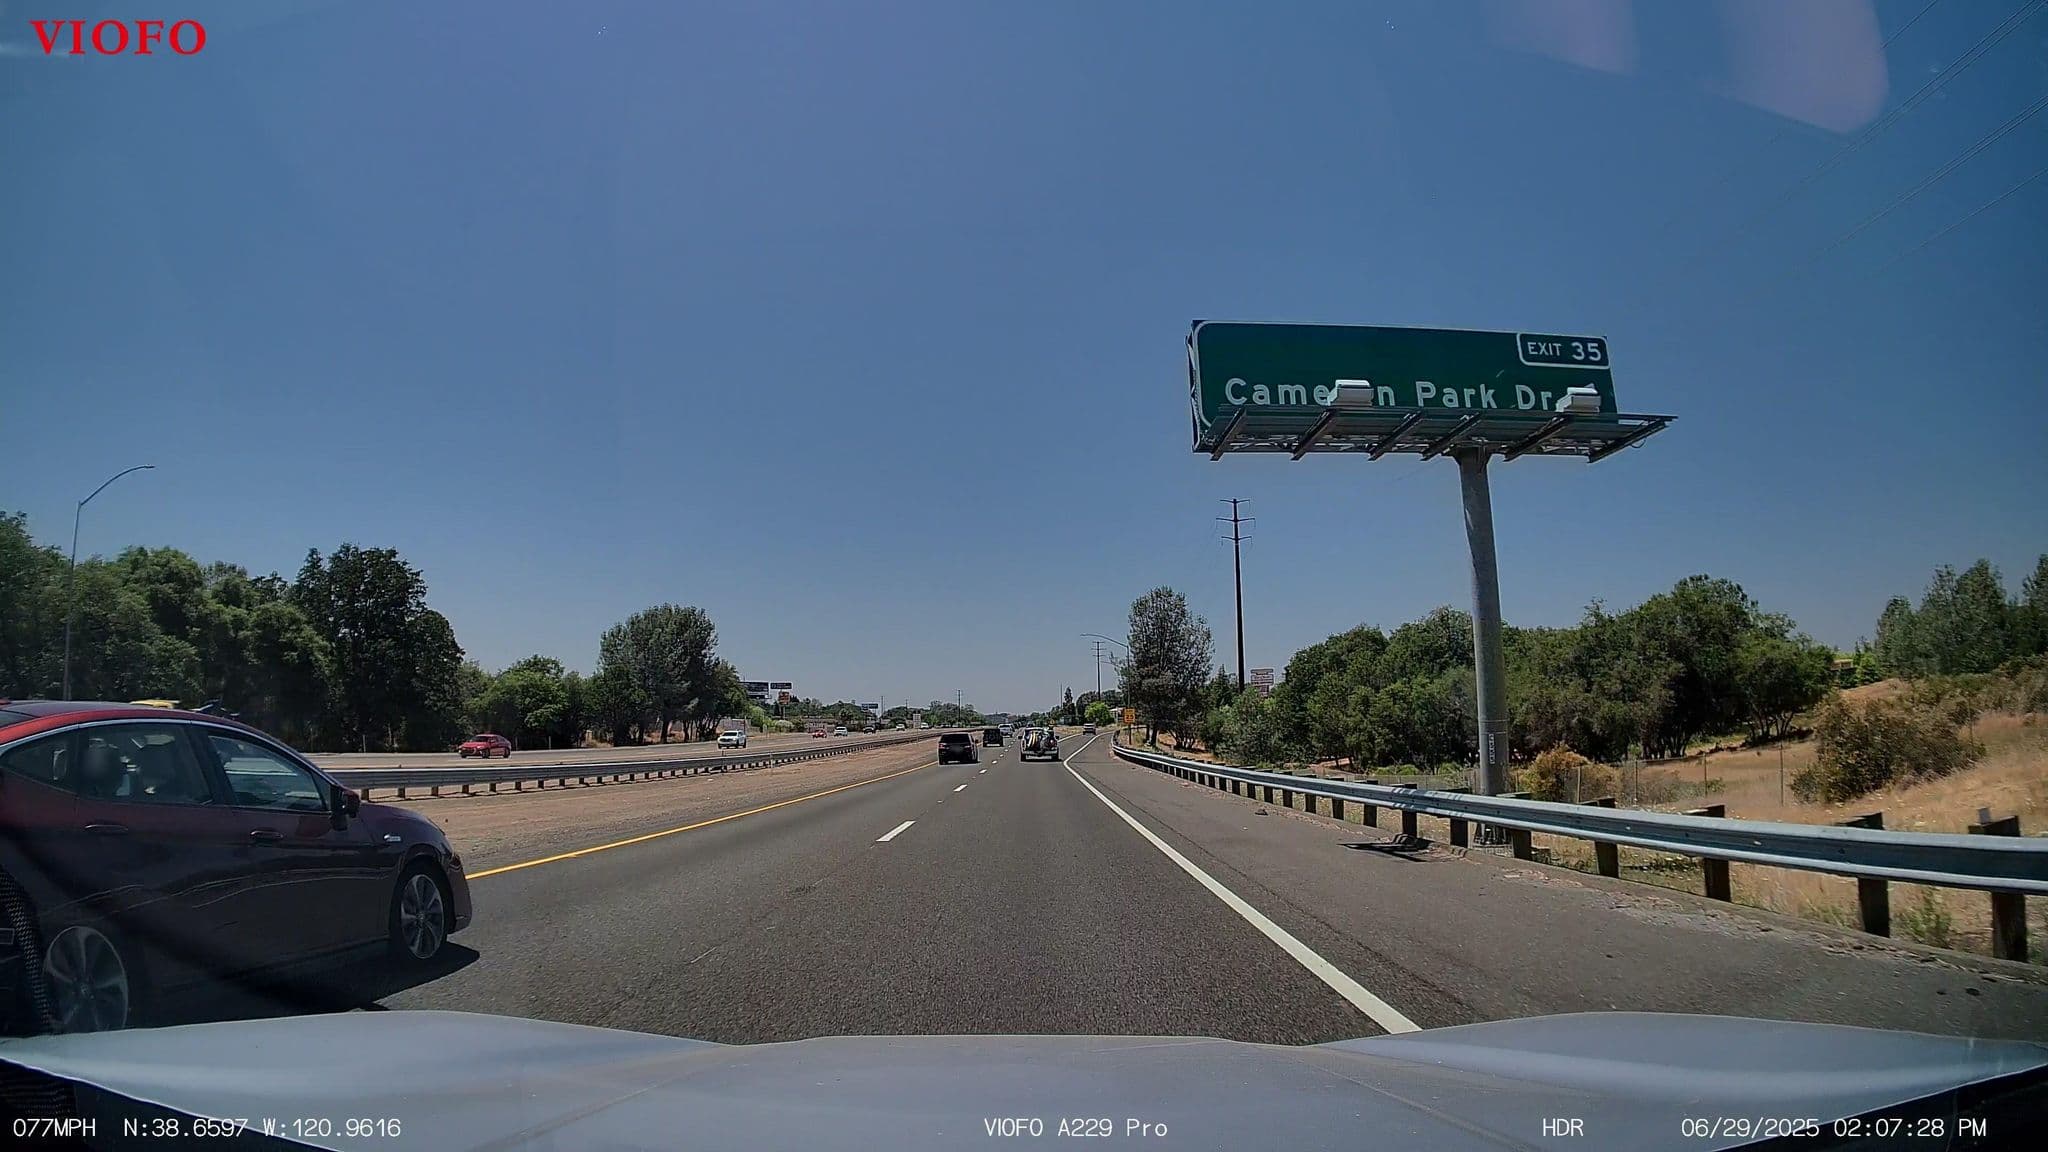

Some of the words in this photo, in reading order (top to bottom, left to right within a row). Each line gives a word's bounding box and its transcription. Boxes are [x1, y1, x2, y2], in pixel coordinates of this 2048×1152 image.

[1527, 342, 1561, 356] EXIT
[1571, 341, 1602, 361] 35
[1225, 377, 1396, 406] Camen
[1415, 380, 1498, 409] Park
[1515, 384, 1553, 411] Dr
